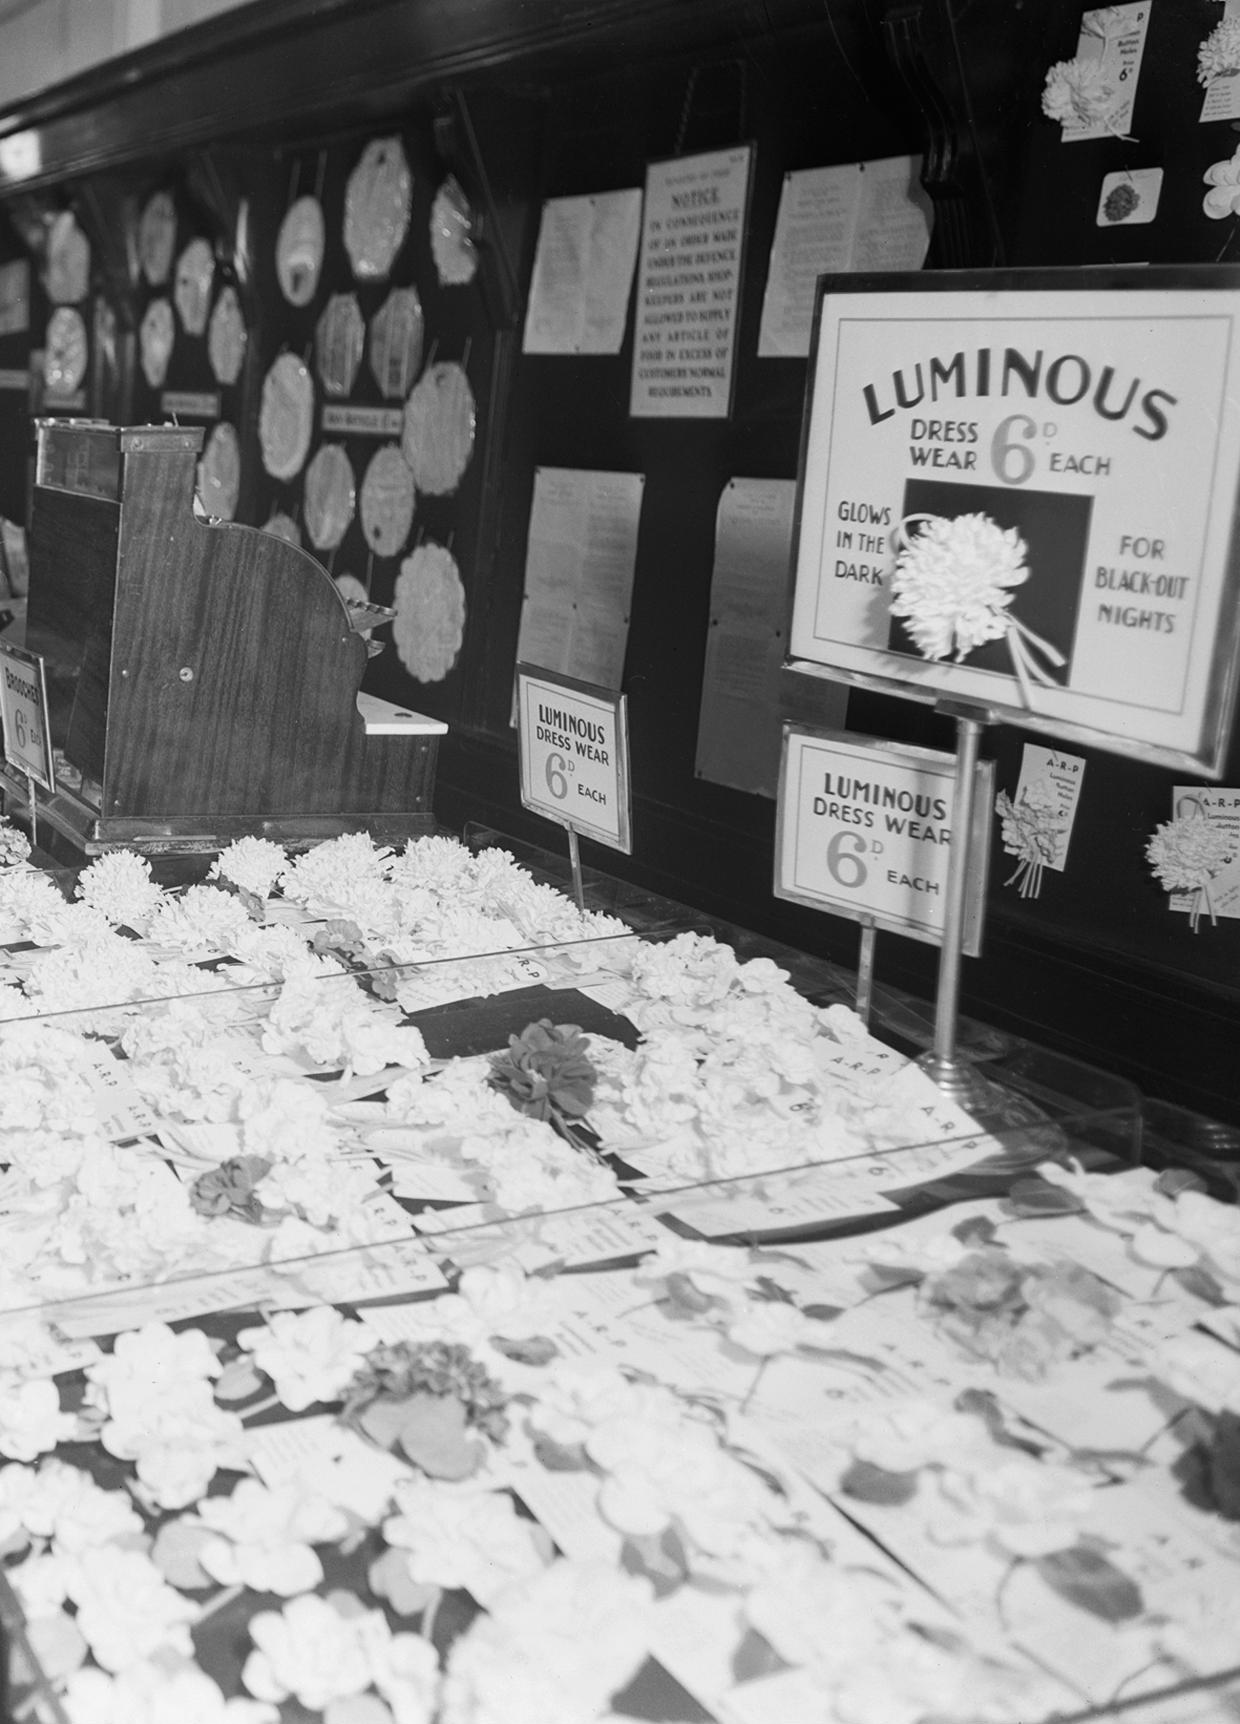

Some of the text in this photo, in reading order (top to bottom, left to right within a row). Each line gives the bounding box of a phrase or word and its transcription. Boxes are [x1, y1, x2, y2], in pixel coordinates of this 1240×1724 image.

[671, 186, 719, 209] NOTICE
[649, 208, 739, 232] IN CONSEQUENCE
[695, 249, 735, 264] DEFENCE
[690, 290, 707, 303] ARE
[712, 287, 733, 300] NOT
[642, 331, 661, 342] ANY
[667, 328, 709, 342] ARTICLE
[678, 348, 713, 360] EXCESS
[862, 347, 1179, 442] LUMINOUS
[910, 418, 979, 443] DRESS
[909, 446, 1112, 477] WEAR EACH
[838, 500, 892, 526] GLOWS
[836, 530, 885, 554] IN THE
[1119, 535, 1165, 560] FOR
[835, 560, 883, 586] DARK
[1094, 566, 1190, 600] BLACK-OUT
[1097, 603, 1176, 634] NIGHTS
[539, 703, 606, 745] LUMINOUS
[536, 725, 609, 767] DRESS WEAR
[577, 783, 607, 805] EACH
[824, 772, 947, 821] LUMINOUS
[813, 796, 953, 846] DRESS WEAR
[887, 869, 940, 896] EACH
